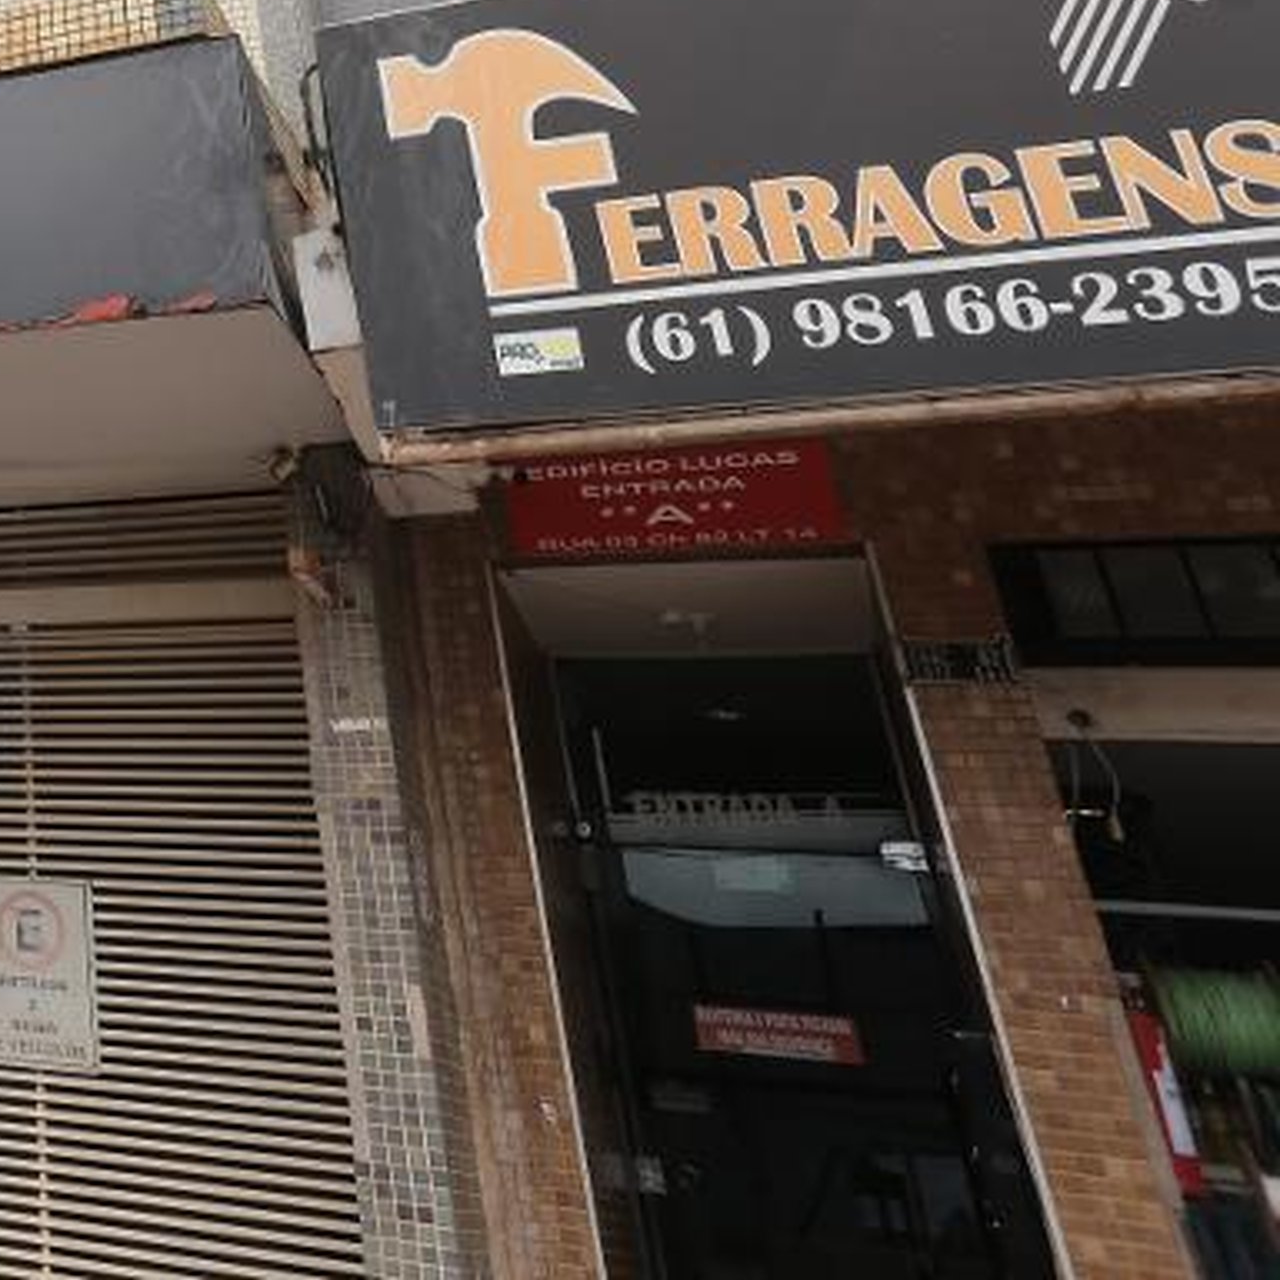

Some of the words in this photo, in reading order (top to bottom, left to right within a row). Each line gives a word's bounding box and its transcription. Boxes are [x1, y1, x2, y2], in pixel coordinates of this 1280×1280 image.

[624, 308, 774, 373] (61)
[794, 254, 1280, 352] 98166-2395
[680, 450, 801, 471] LUCAS
[581, 474, 747, 499] ENTRADA
